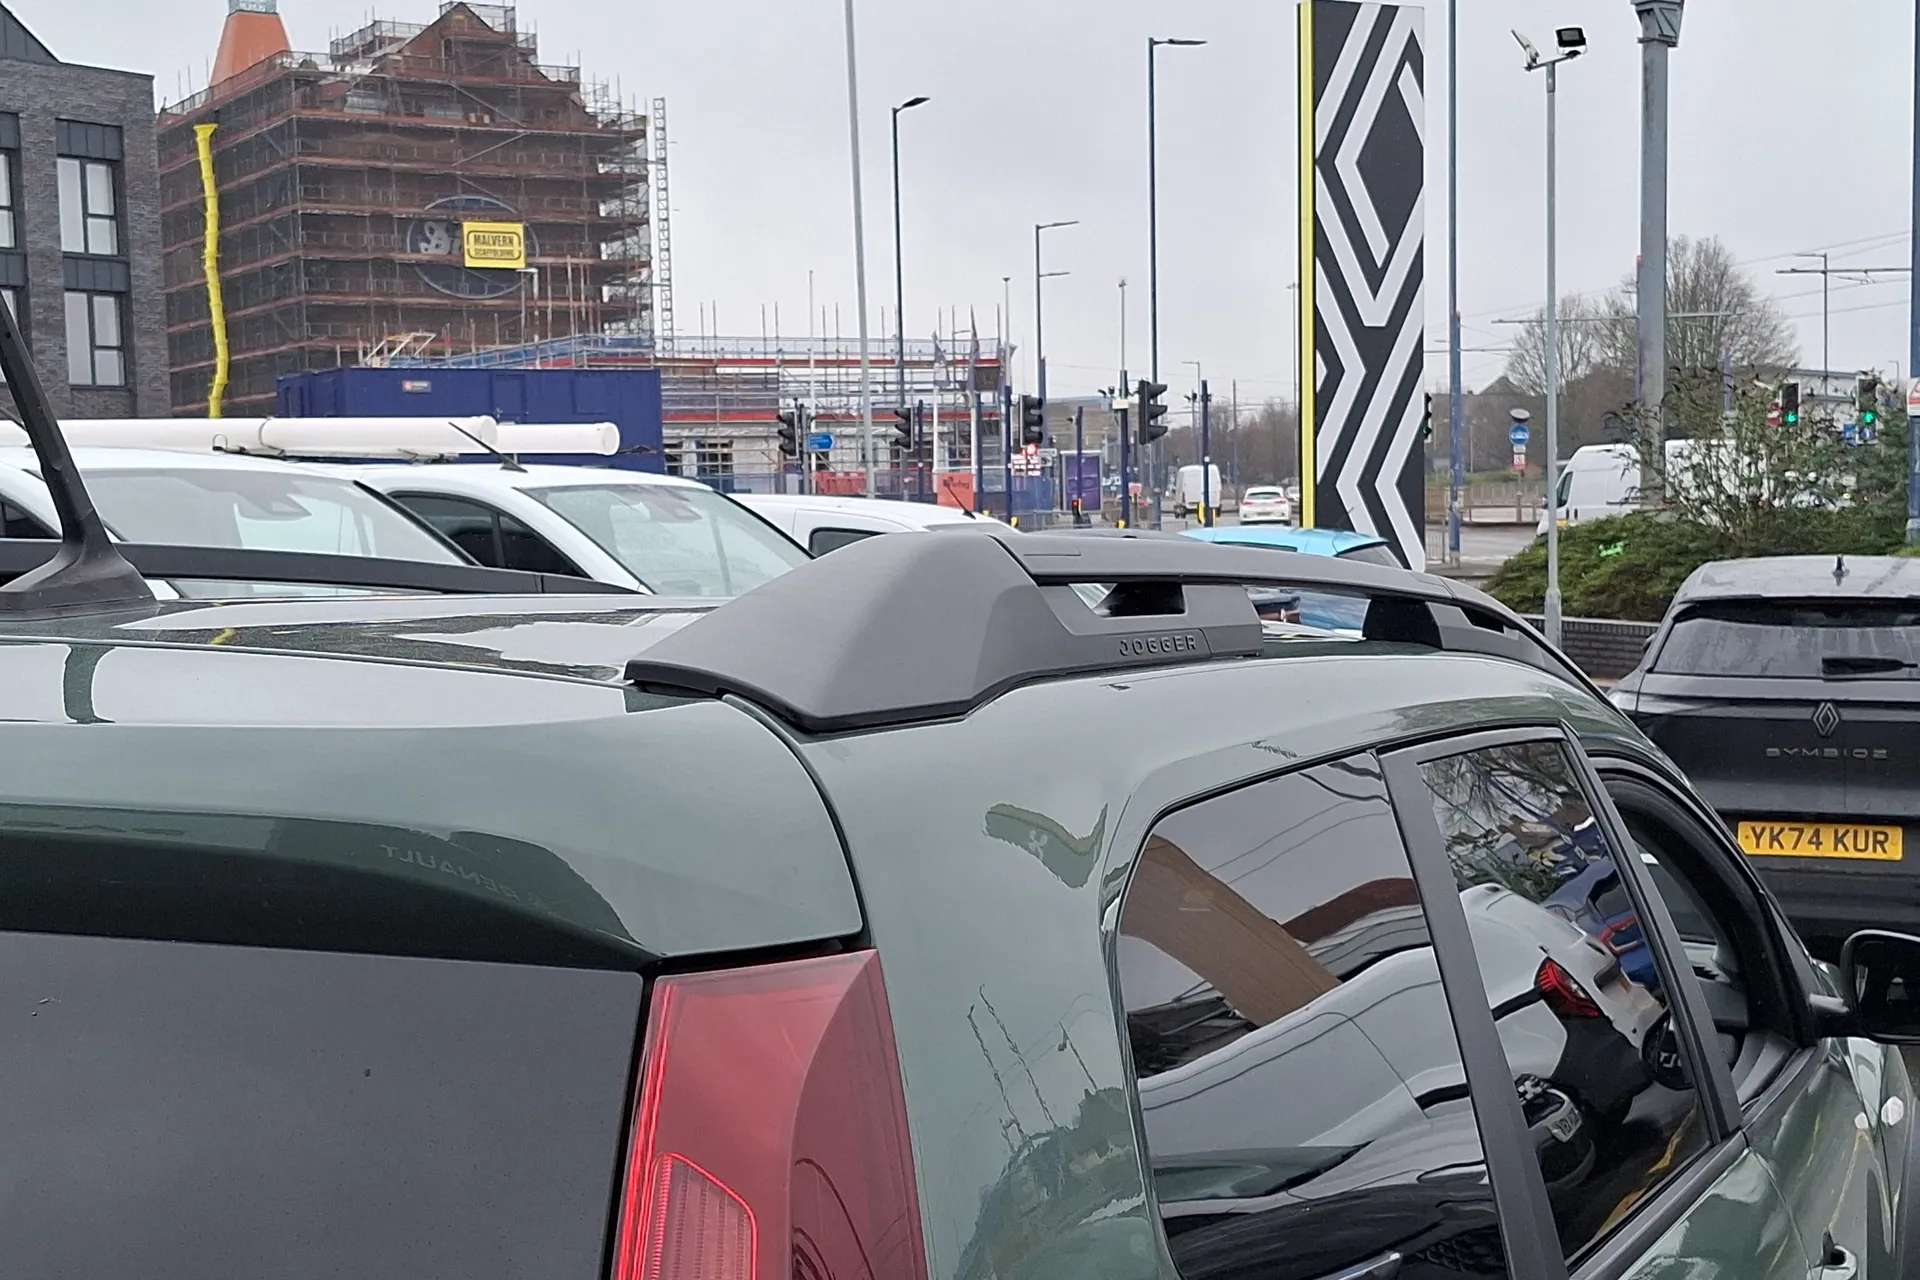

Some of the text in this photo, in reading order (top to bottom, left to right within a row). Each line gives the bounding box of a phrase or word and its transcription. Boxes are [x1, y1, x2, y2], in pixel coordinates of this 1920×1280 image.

[473, 234, 514, 247] MALVERN
[1119, 634, 1197, 656] JOGGER
[1750, 826, 1890, 854] YK74 KUR
